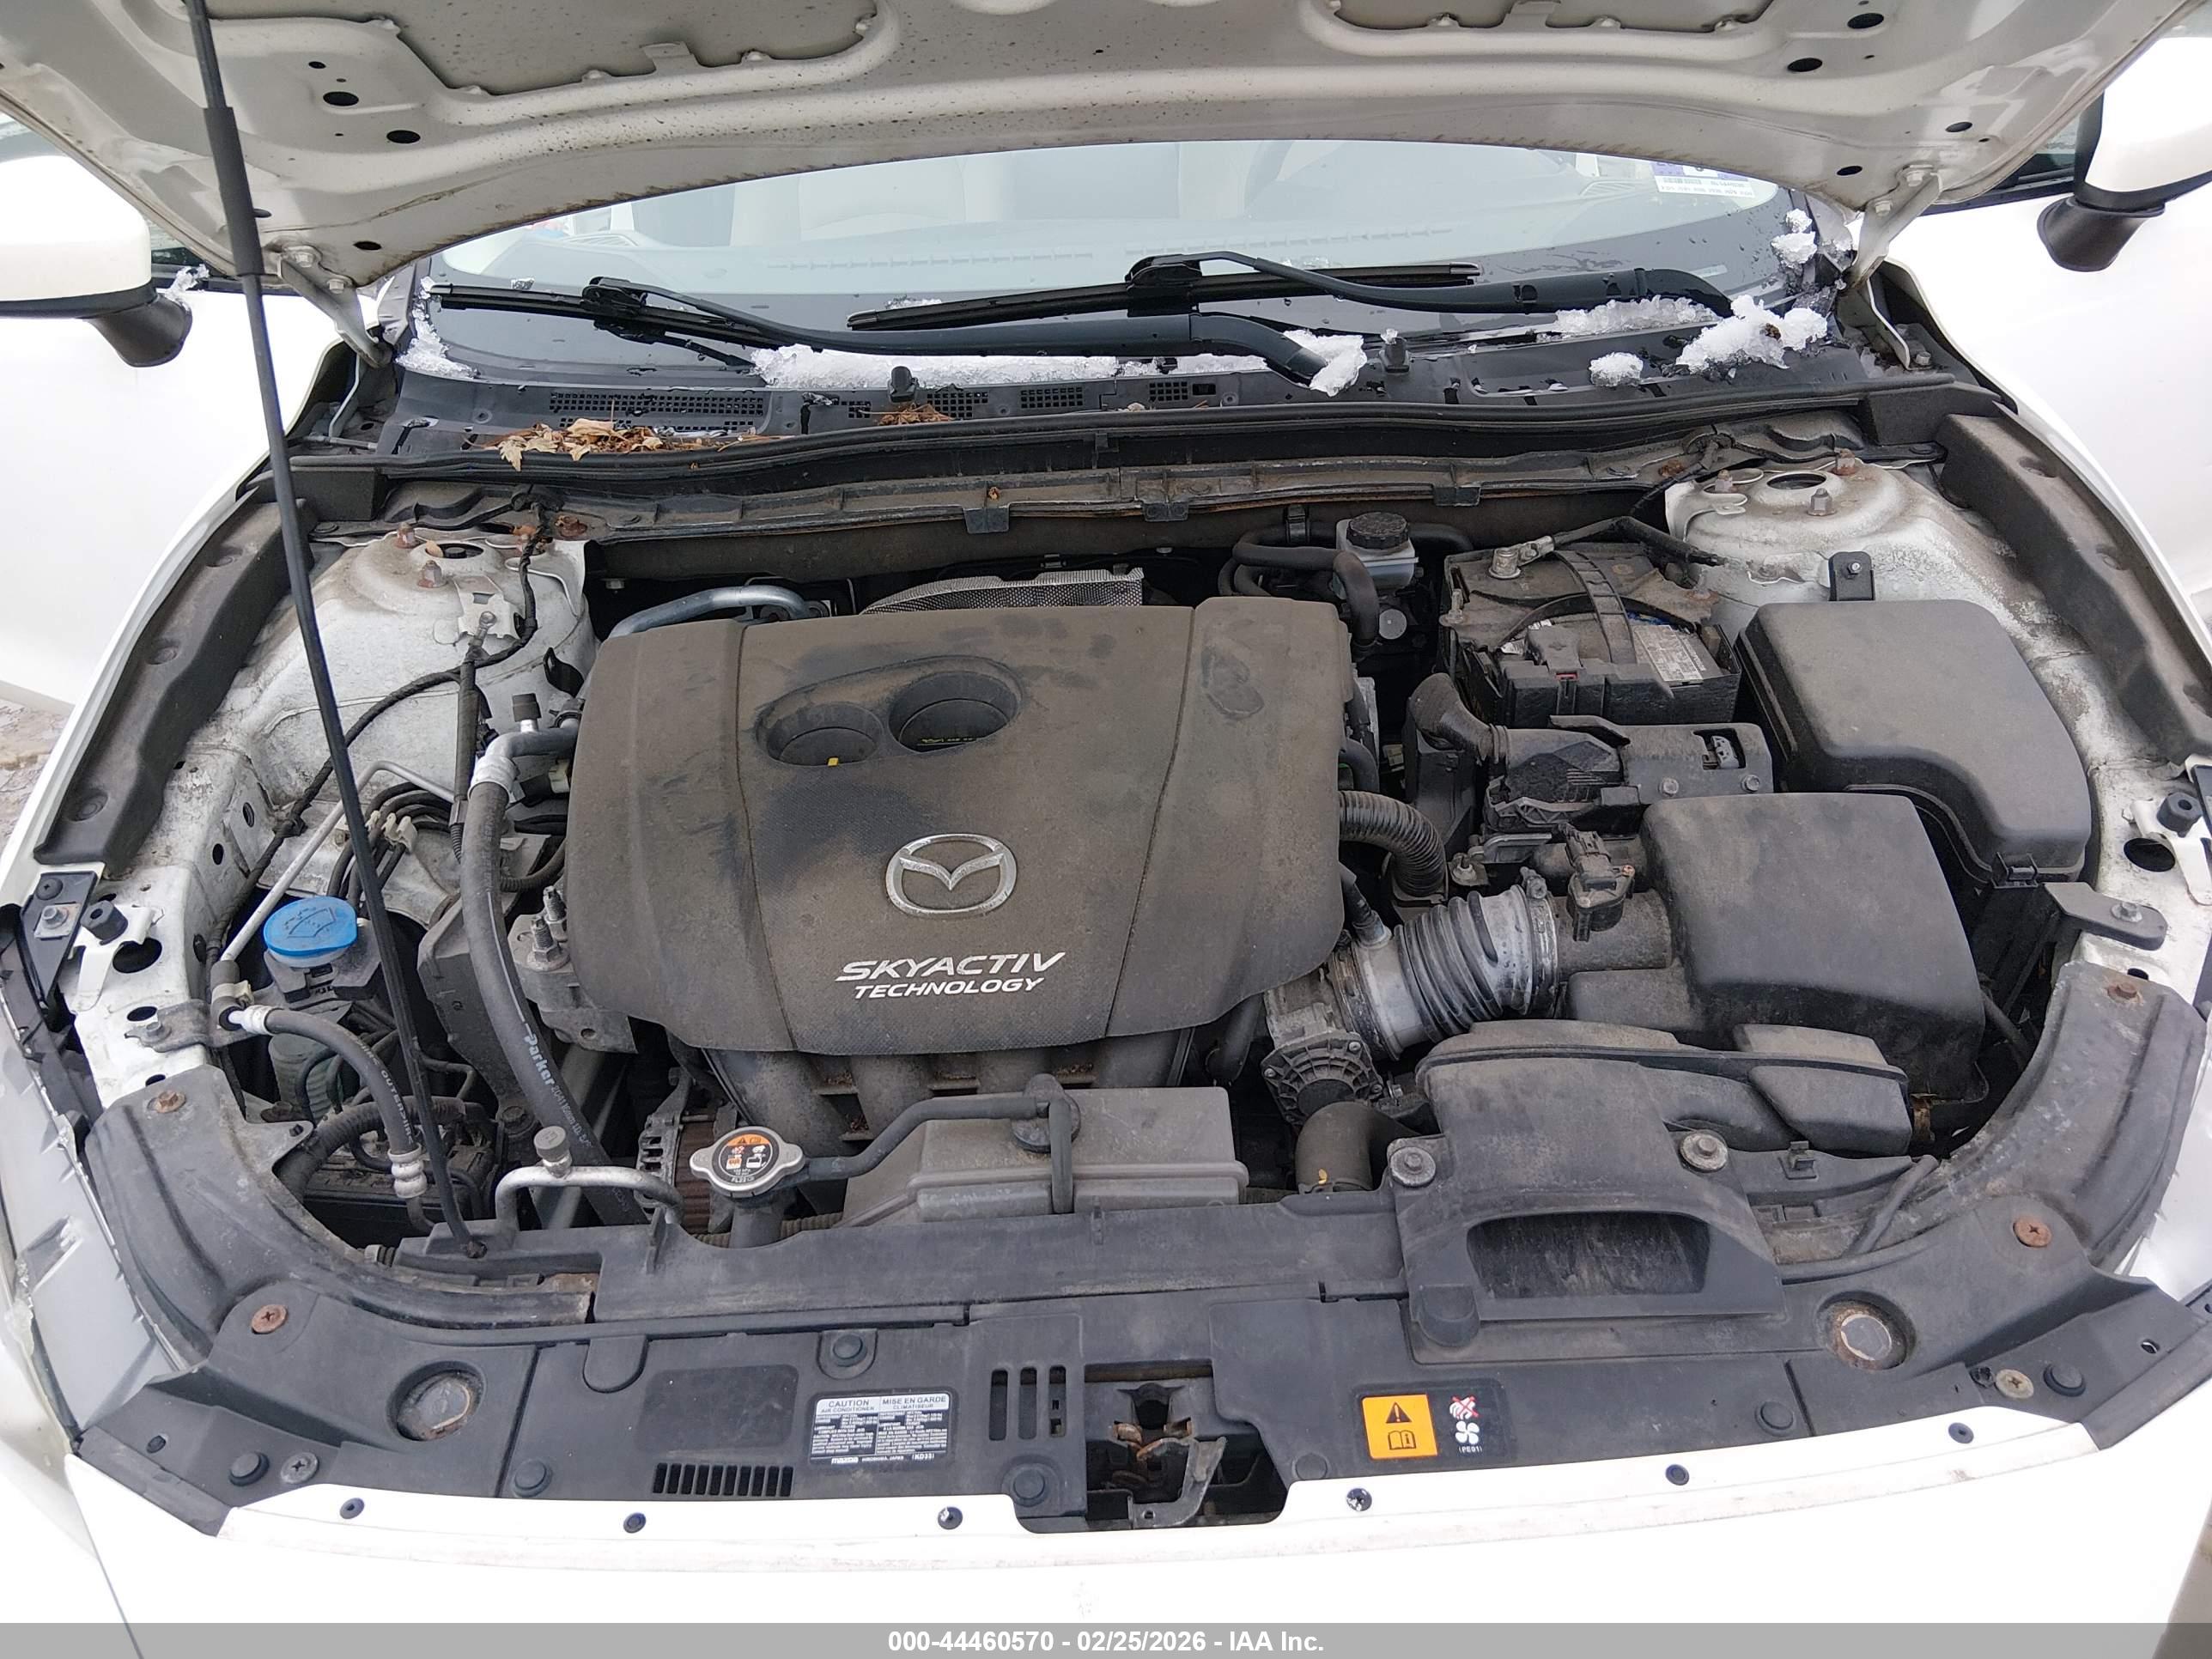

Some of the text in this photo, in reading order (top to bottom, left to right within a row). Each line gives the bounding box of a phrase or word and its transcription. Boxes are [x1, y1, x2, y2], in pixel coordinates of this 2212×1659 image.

[835, 952, 1066, 981] SKYACTIV
[854, 977, 1045, 1000] TECHNOLOGY
[525, 1034, 556, 1085] Parker
[829, 1399, 870, 1407] CAUTION
